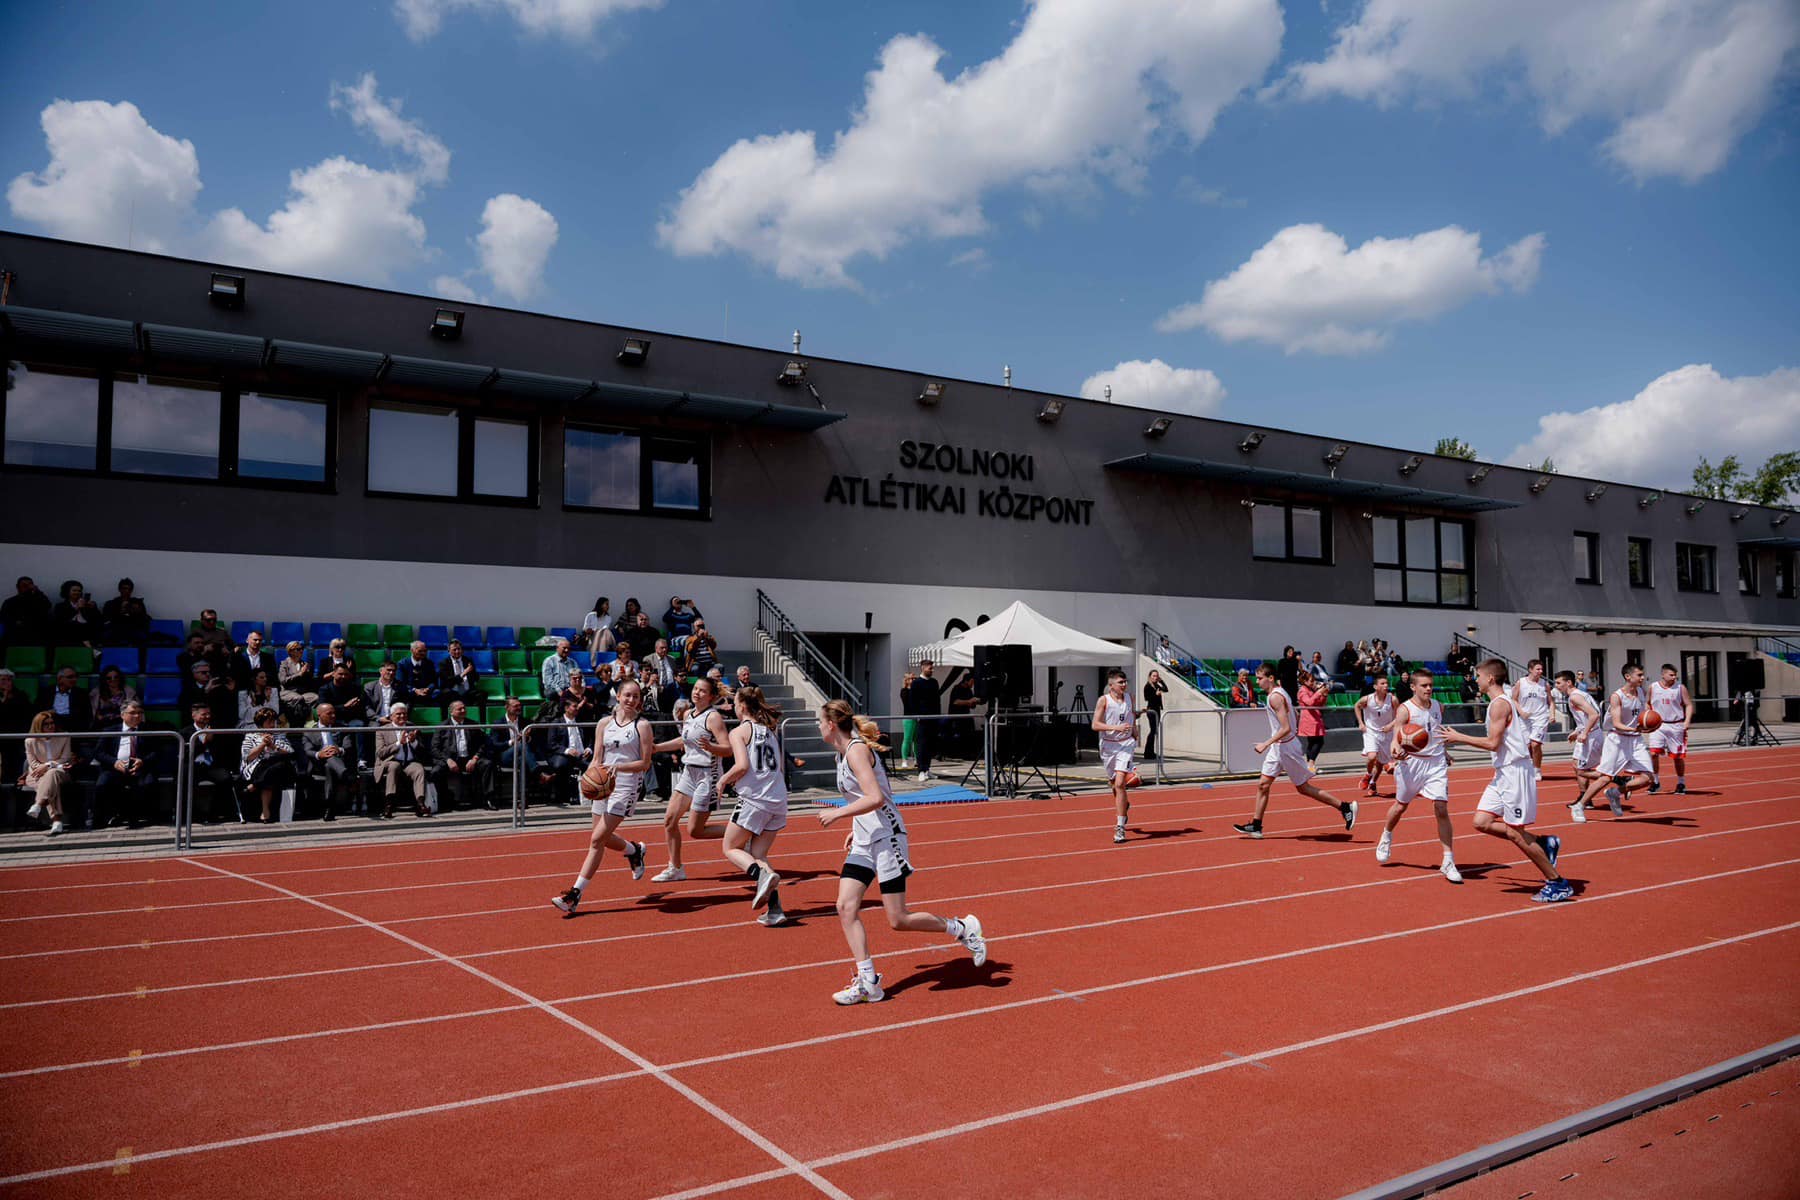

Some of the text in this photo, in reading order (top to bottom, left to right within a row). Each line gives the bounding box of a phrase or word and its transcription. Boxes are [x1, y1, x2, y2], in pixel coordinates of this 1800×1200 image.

[900, 440, 1034, 481] SZOLNOKI
[824, 473, 965, 514] ATLÉTIKAI
[1514, 808, 1522, 818] 9
